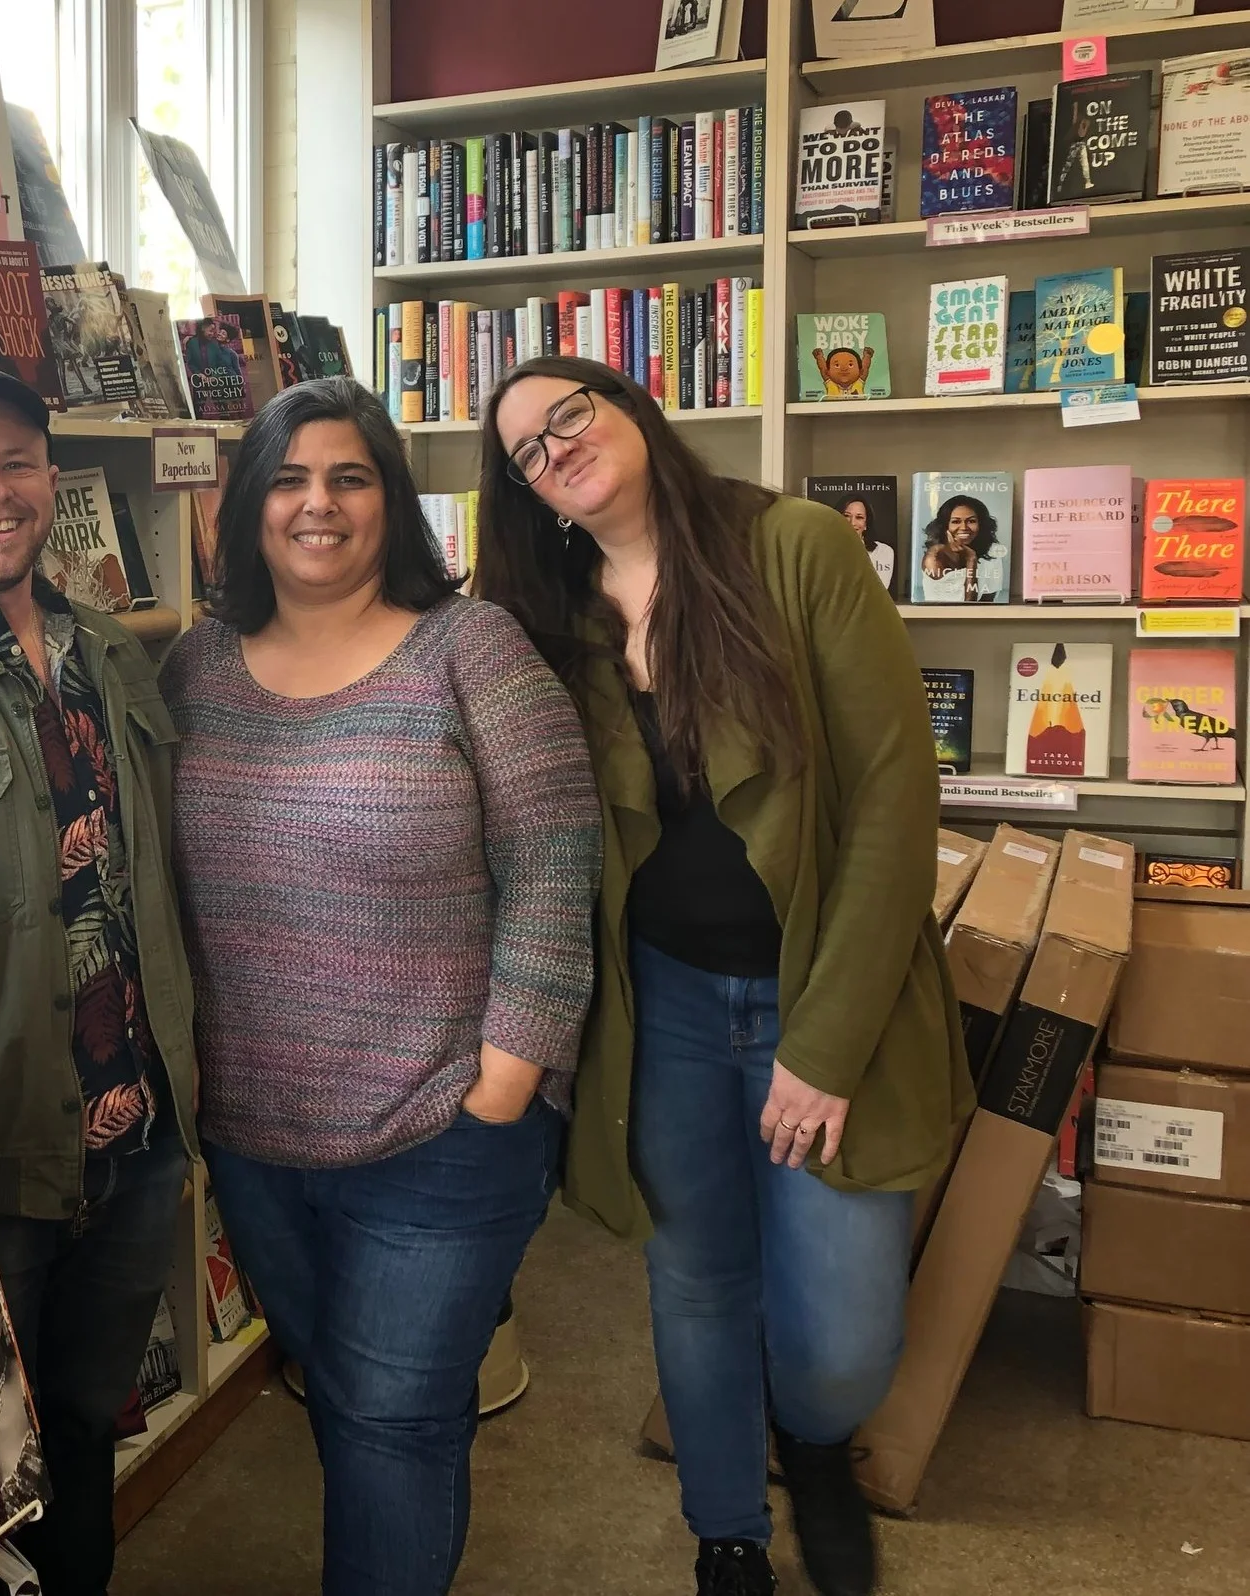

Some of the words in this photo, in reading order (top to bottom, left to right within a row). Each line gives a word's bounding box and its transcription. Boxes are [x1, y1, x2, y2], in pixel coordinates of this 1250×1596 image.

[972, 94, 1006, 104] LASKAR
[1086, 100, 1112, 116] ON
[953, 110, 984, 124] THE
[1096, 115, 1129, 132] THE
[942, 128, 995, 145] ATLAS
[1086, 131, 1138, 151] COME
[684, 138, 692, 167] LEAN
[805, 143, 837, 157] TO
[843, 138, 880, 152] DO
[931, 152, 949, 165] OF
[962, 146, 1006, 161] REDS
[1091, 152, 1116, 168] UP
[802, 153, 880, 185] MORE
[950, 167, 983, 180] AND
[652, 160, 662, 199] HERITAGE
[801, 184, 828, 192] THAN
[831, 179, 878, 189] SURVIVE
[684, 171, 692, 208] IMPACT
[940, 184, 994, 200] BLUES
[1013, 214, 1074, 228] Bestsellers
[40, 270, 112, 291] RESISTANCE
[1164, 266, 1241, 292] WHITE
[1160, 289, 1246, 312] FRAGILITY
[1038, 304, 1107, 319] AMERICAN
[814, 315, 869, 332] WOKE
[1043, 315, 1110, 331] MARRIAGE
[816, 330, 868, 349] BABY
[1042, 346, 1085, 358] TAYARI
[205, 366, 228, 375] ONCE
[1062, 357, 1102, 368] JONES
[1158, 359, 1191, 370] ROBIN
[1196, 355, 1247, 368] DIANGELO
[191, 373, 246, 388] GHOSTED,
[196, 388, 222, 398] TWICE
[223, 387, 244, 398] SHY
[177, 441, 196, 456] New
[162, 462, 211, 480] Paperbacks
[814, 483, 853, 492] Kamala
[856, 482, 890, 491] Harris
[924, 482, 1008, 493] BECOMING
[1032, 500, 1055, 508] THE
[1058, 498, 1106, 508] SOURCE
[1108, 497, 1124, 506] OF
[1157, 490, 1236, 514] There
[1032, 511, 1125, 523] SELF-REGARD
[1154, 534, 1235, 559] There
[924, 568, 1001, 580] MICHELLE
[1033, 574, 1111, 585] MORRISON
[1016, 688, 1102, 704] Educated
[964, 787, 998, 796] Bound
[1008, 1018, 1058, 1117] STAKMORE
